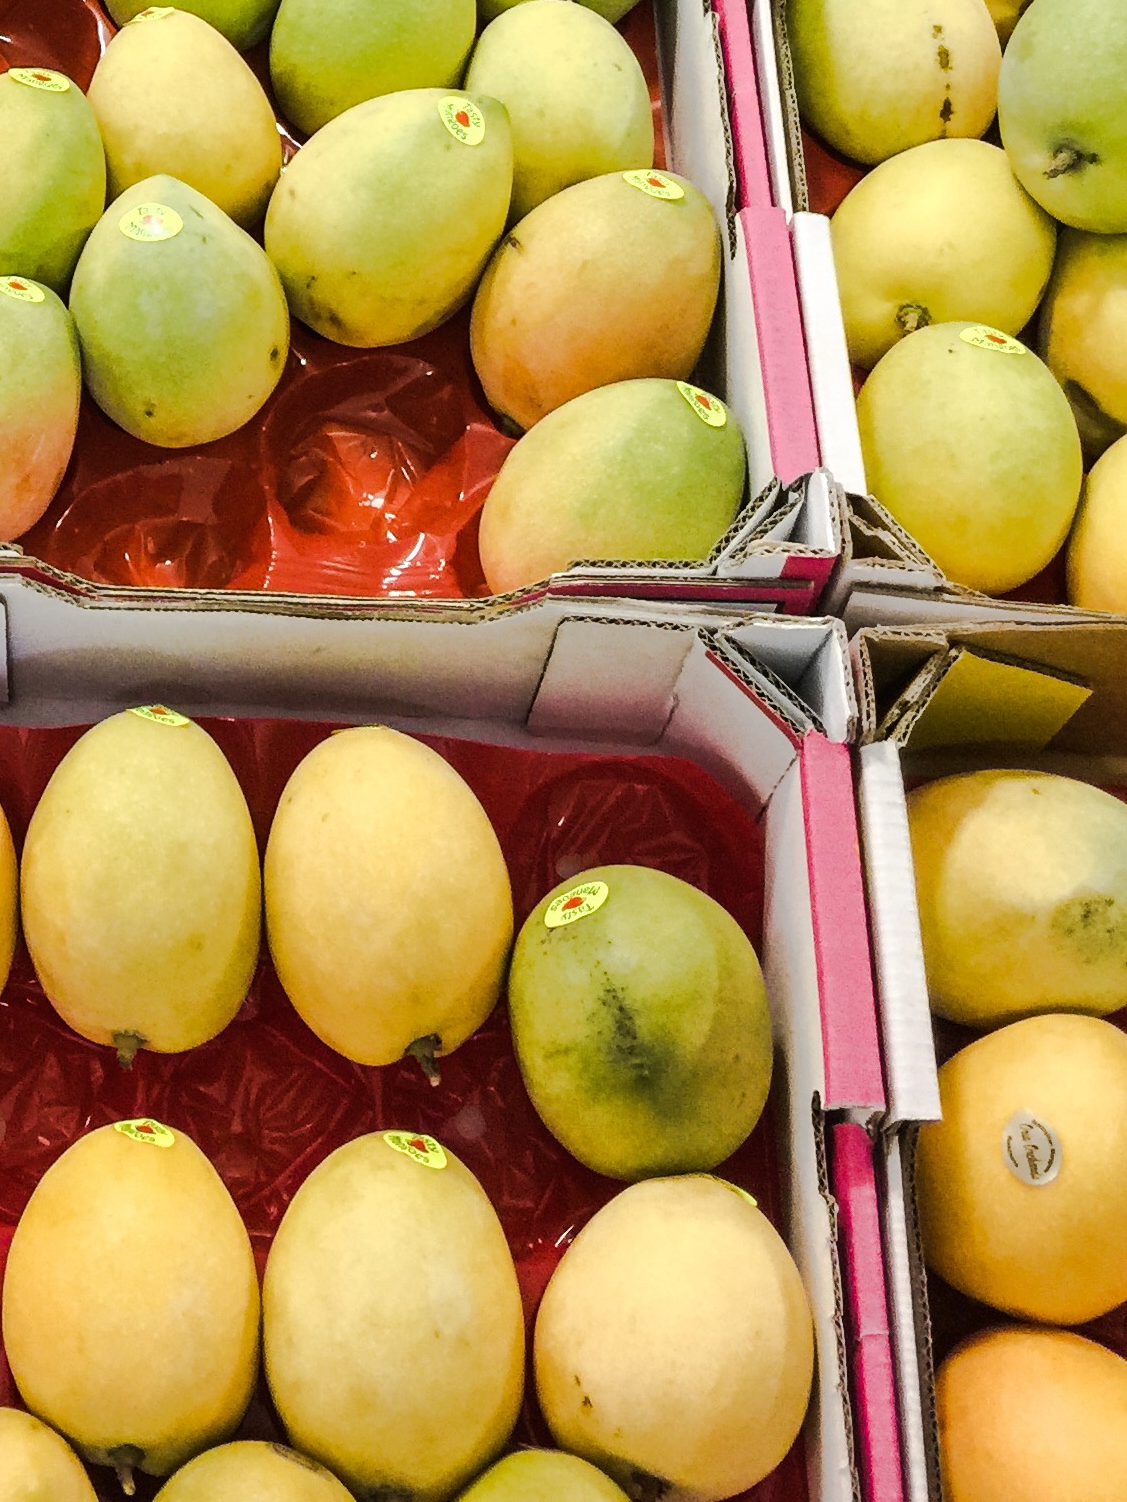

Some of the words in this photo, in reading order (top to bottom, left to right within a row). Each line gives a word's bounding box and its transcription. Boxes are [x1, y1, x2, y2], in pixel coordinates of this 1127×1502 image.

[462, 102, 481, 128] Tasty
[550, 885, 601, 912] Mangoes
[561, 903, 595, 921] Tasty
